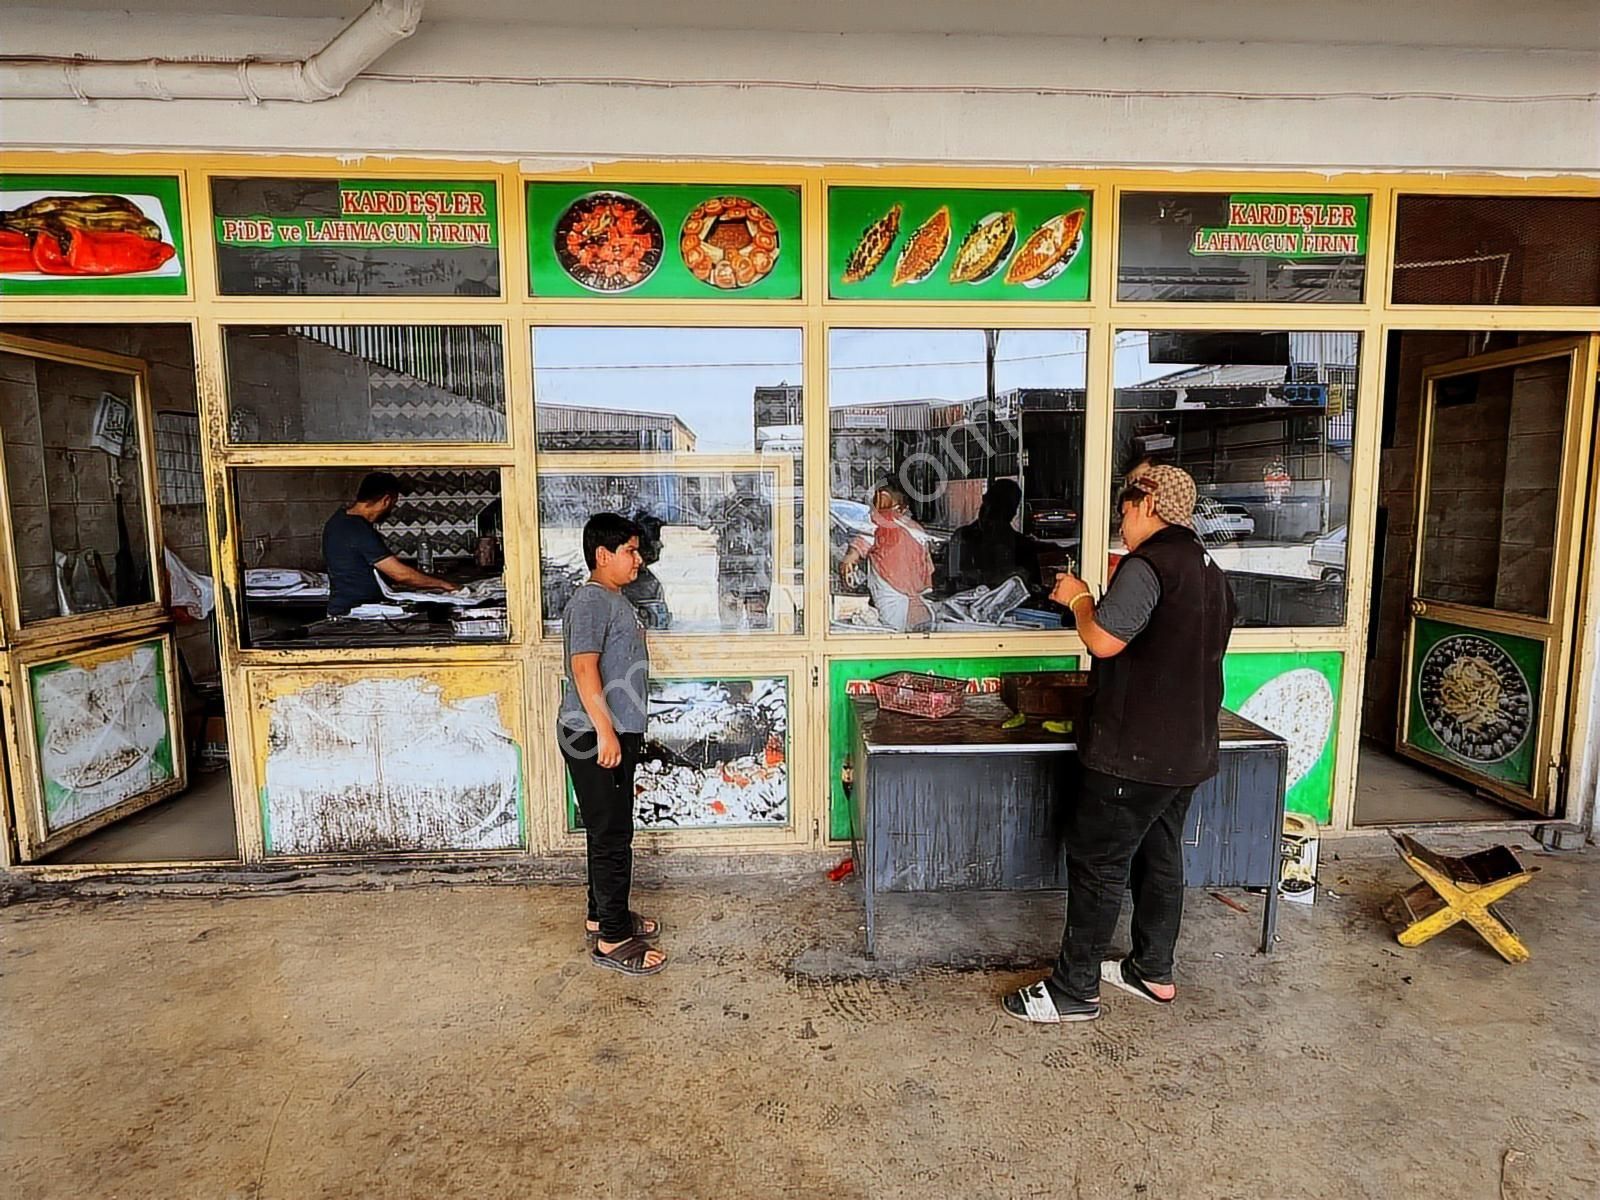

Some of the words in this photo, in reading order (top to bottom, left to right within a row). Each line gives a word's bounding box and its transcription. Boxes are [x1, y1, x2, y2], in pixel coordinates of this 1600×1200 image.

[340, 190, 485, 221] KARDEŞLER
[1229, 203, 1356, 232] KARDEŞLER
[279, 227, 301, 241] ve
[306, 220, 421, 243] LAHMACUN
[427, 222, 491, 244] FIRINI
[1194, 232, 1298, 254] LAHMACUN
[1303, 232, 1358, 255] FIRINI
